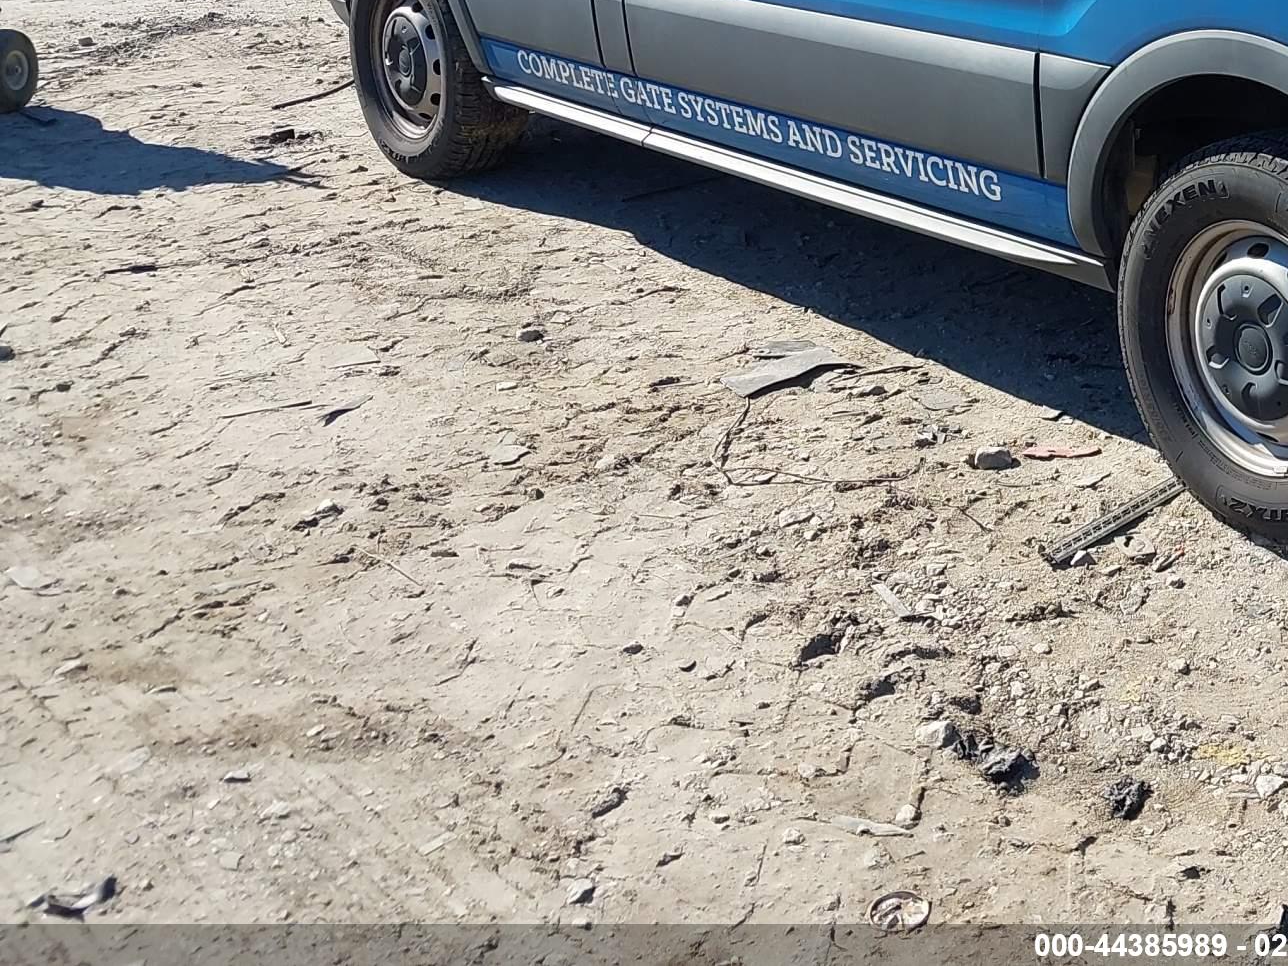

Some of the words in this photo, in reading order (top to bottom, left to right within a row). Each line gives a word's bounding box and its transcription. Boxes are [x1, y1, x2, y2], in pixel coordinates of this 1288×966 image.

[517, 50, 618, 99] COMPLETE
[619, 77, 676, 115] GATE
[680, 92, 783, 144] SYSTEMS
[787, 120, 843, 159] AND
[847, 135, 1001, 201] SERVICING
[1145, 179, 1218, 232] NEXEN
